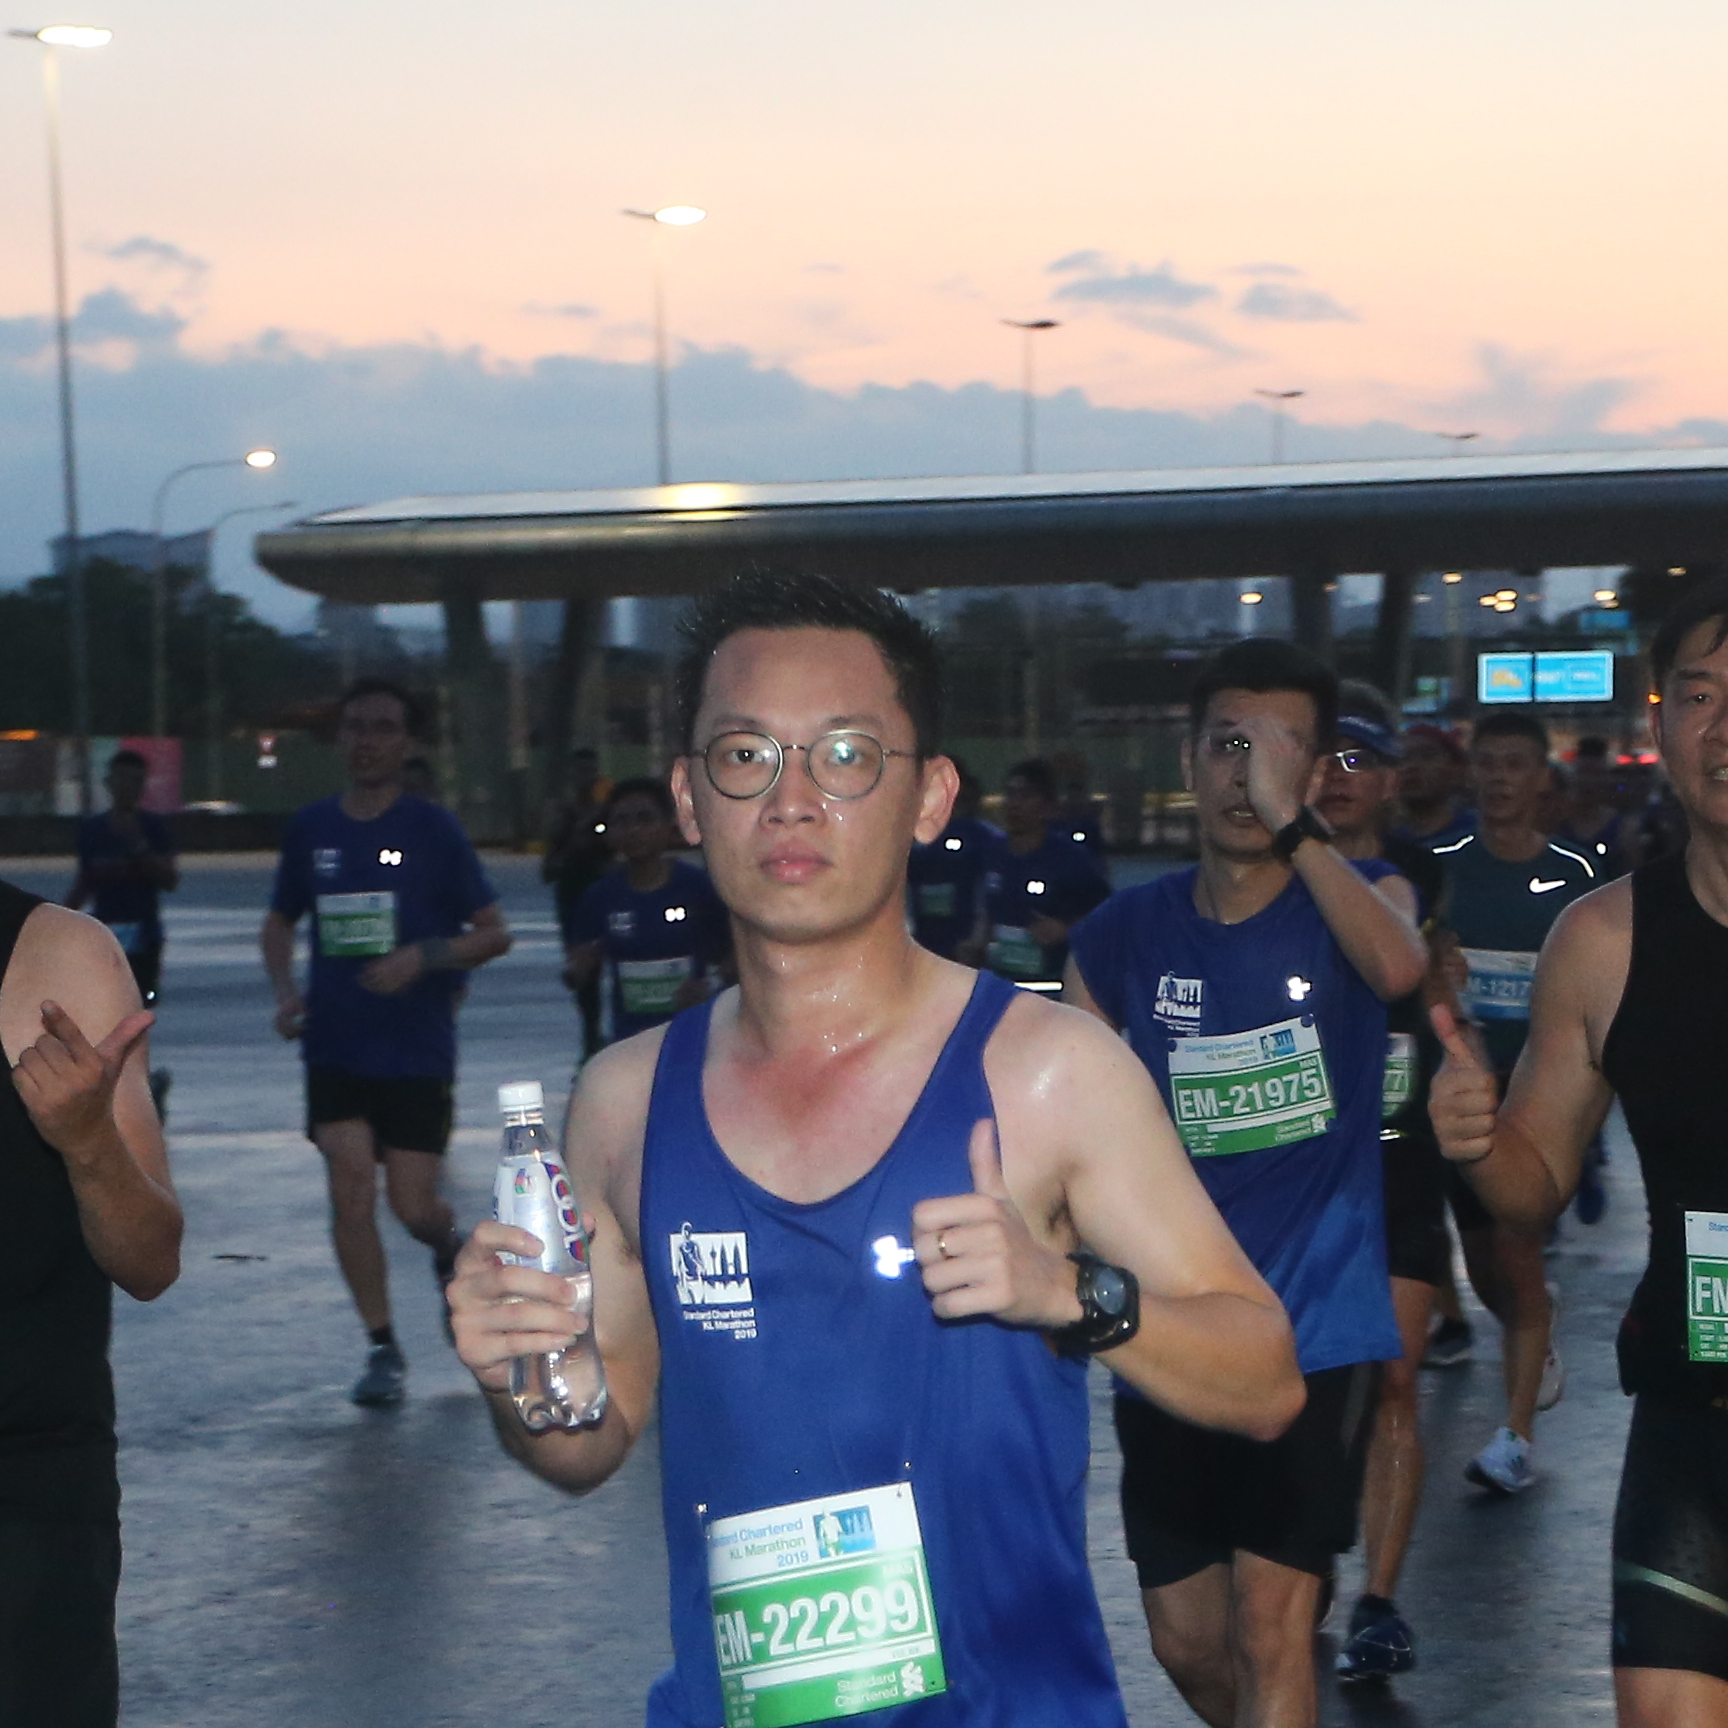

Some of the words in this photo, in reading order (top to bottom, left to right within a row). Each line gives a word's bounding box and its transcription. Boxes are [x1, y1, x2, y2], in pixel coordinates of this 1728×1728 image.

[1177, 1068, 1322, 1120] EM-21975
[739, 1518, 804, 1541] Chartered
[745, 1537, 807, 1557] Marathon
[777, 1550, 809, 1568] 2019
[716, 1579, 920, 1666] EM-22299
